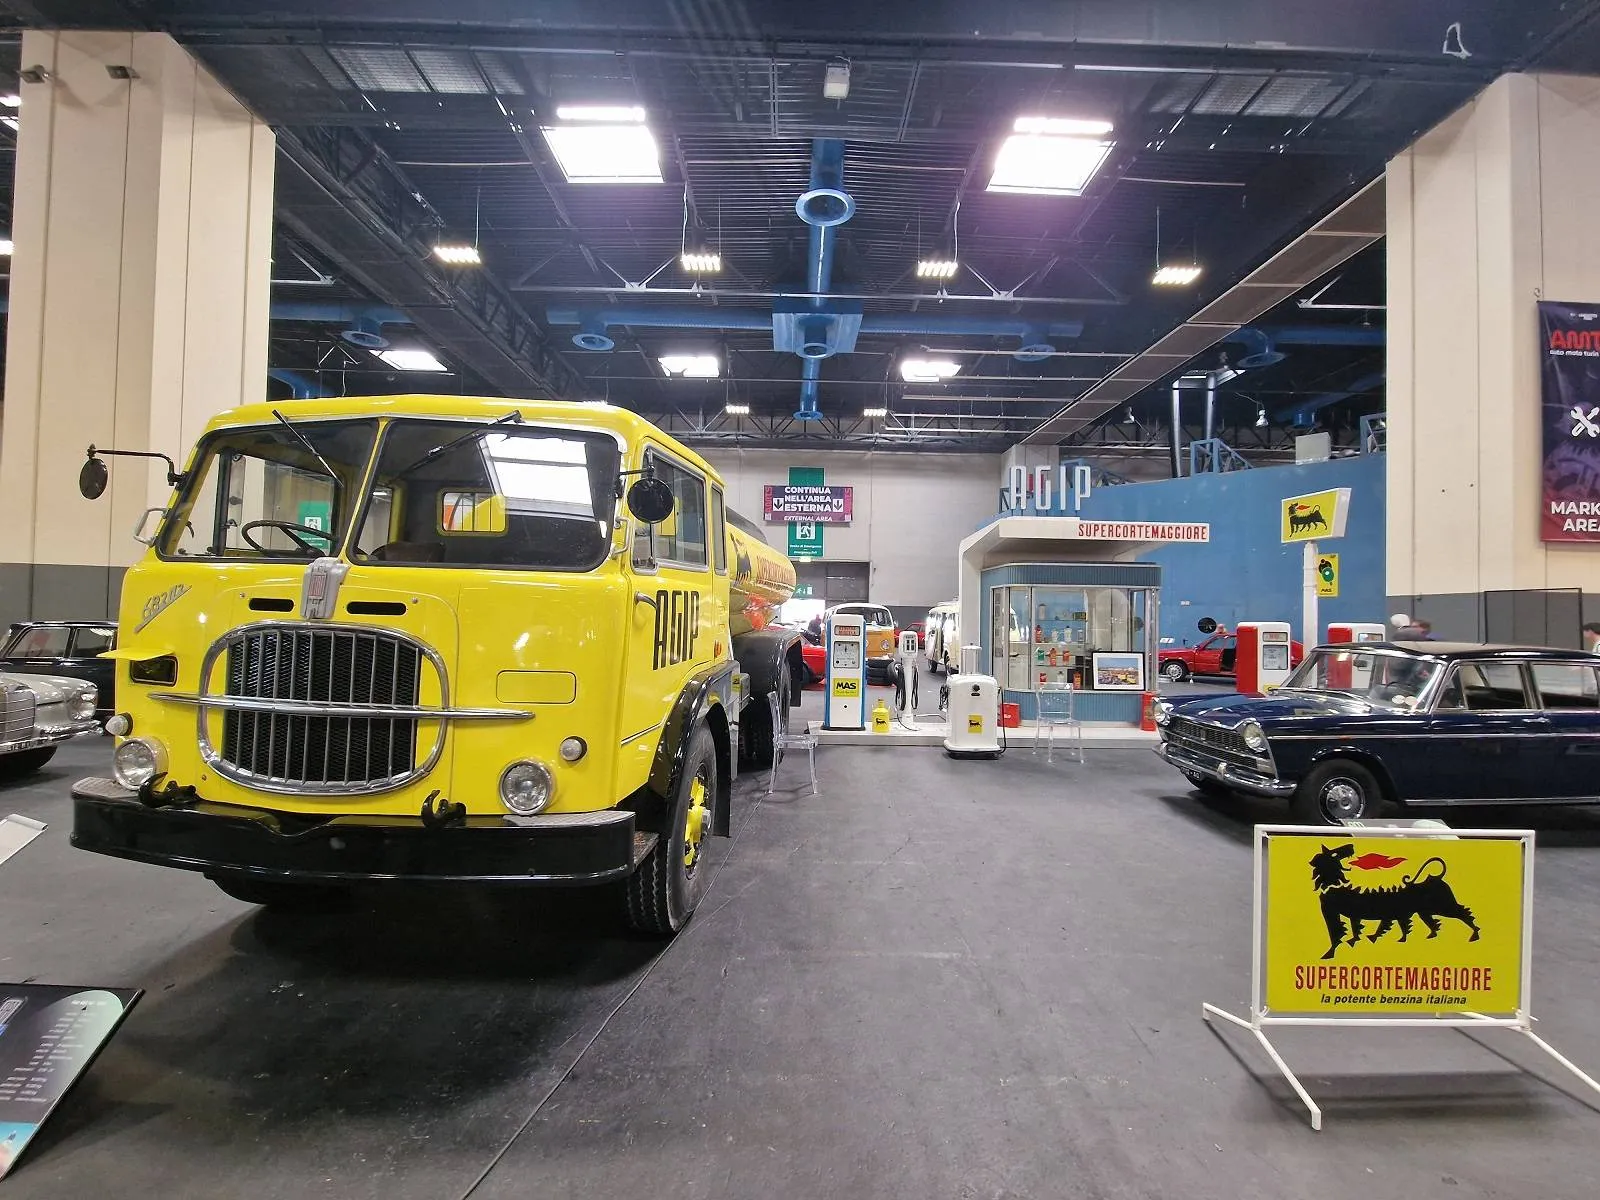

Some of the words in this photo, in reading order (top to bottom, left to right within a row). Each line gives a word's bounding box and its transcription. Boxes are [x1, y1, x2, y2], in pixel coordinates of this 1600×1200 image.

[784, 486, 832, 494] CONTINUA
[1010, 465, 1091, 511] AGIP
[784, 494, 832, 503] NELL'AREA
[784, 503, 832, 512] ESTERNA
[1078, 523, 1207, 540] SUPERCORTEMAGGIORE
[1562, 518, 1600, 532] ARE
[653, 590, 700, 671] AGIP
[836, 682, 857, 690] MAS
[1295, 965, 1492, 991] SUPERCORTEMAGGIORE
[1320, 994, 1331, 1004] la
[1334, 994, 1377, 1006] potente
[1379, 994, 1423, 1005] benzina
[1426, 994, 1467, 1005] italiana
